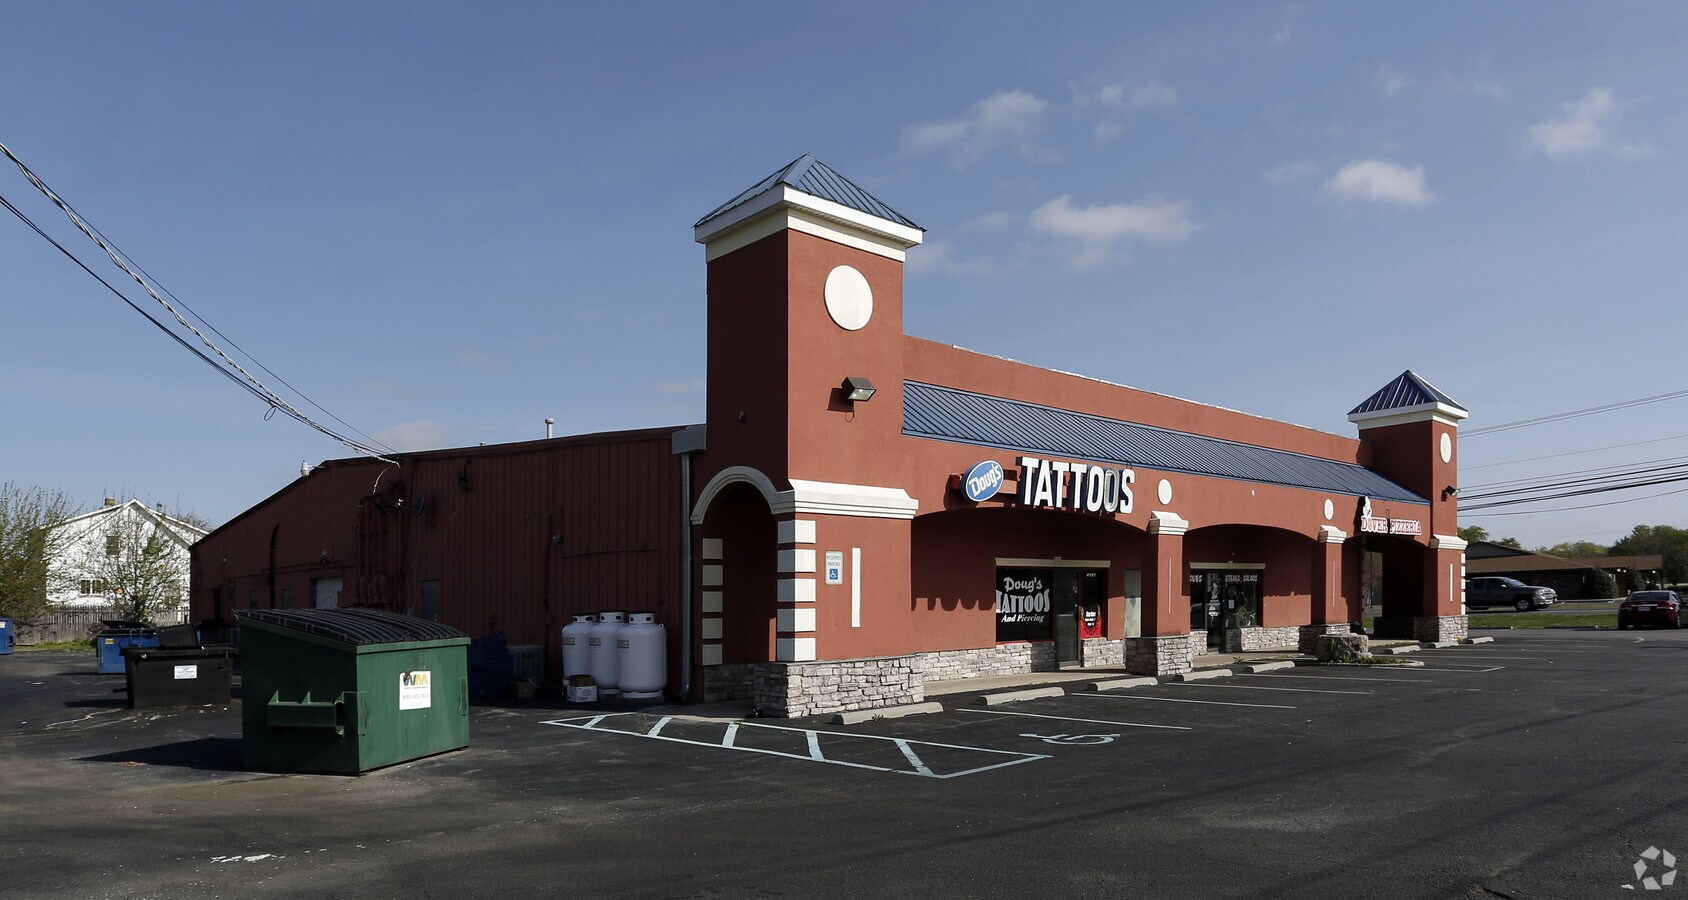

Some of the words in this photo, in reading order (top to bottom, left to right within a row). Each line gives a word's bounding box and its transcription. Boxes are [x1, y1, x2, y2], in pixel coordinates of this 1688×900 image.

[968, 463, 1002, 497] Doug's
[1021, 456, 1135, 514] TATTOOS
[1390, 518, 1422, 535] PIZZERIA
[1003, 576, 1043, 593] Doug's
[995, 588, 1050, 613] TATTOOS
[1000, 614, 1016, 623] And
[1016, 613, 1045, 623] Piercing
